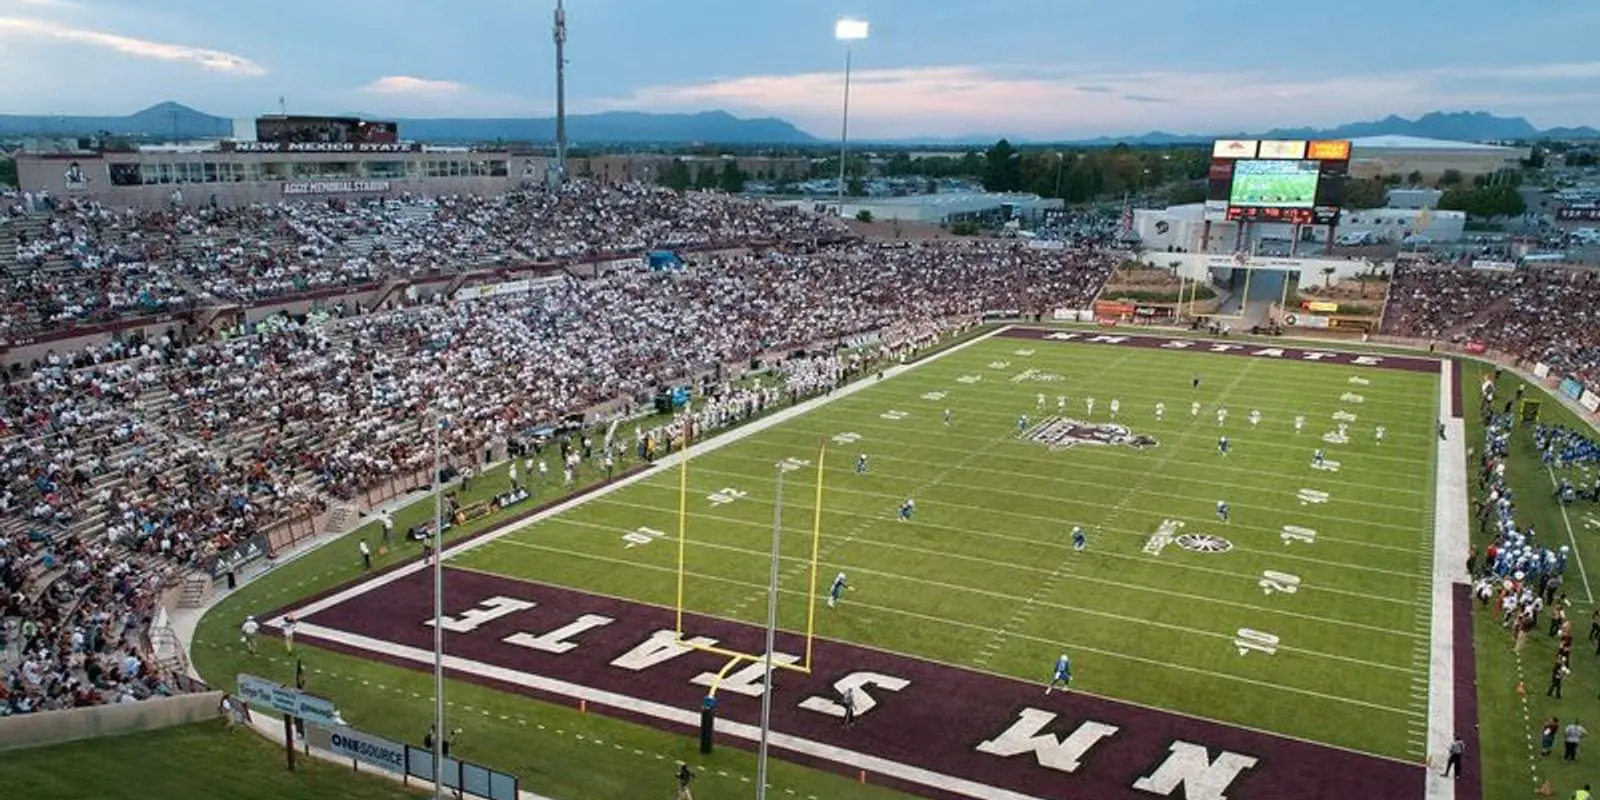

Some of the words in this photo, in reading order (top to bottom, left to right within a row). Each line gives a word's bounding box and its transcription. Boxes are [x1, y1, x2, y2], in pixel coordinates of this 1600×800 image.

[236, 143, 280, 151] NEW
[288, 143, 354, 151] MEXICO
[359, 143, 412, 151] STATE
[284, 182, 309, 193] AGGIE
[310, 181, 352, 193] MEMORIAL
[424, 596, 911, 718] STATE
[976, 707, 1259, 800] NM
